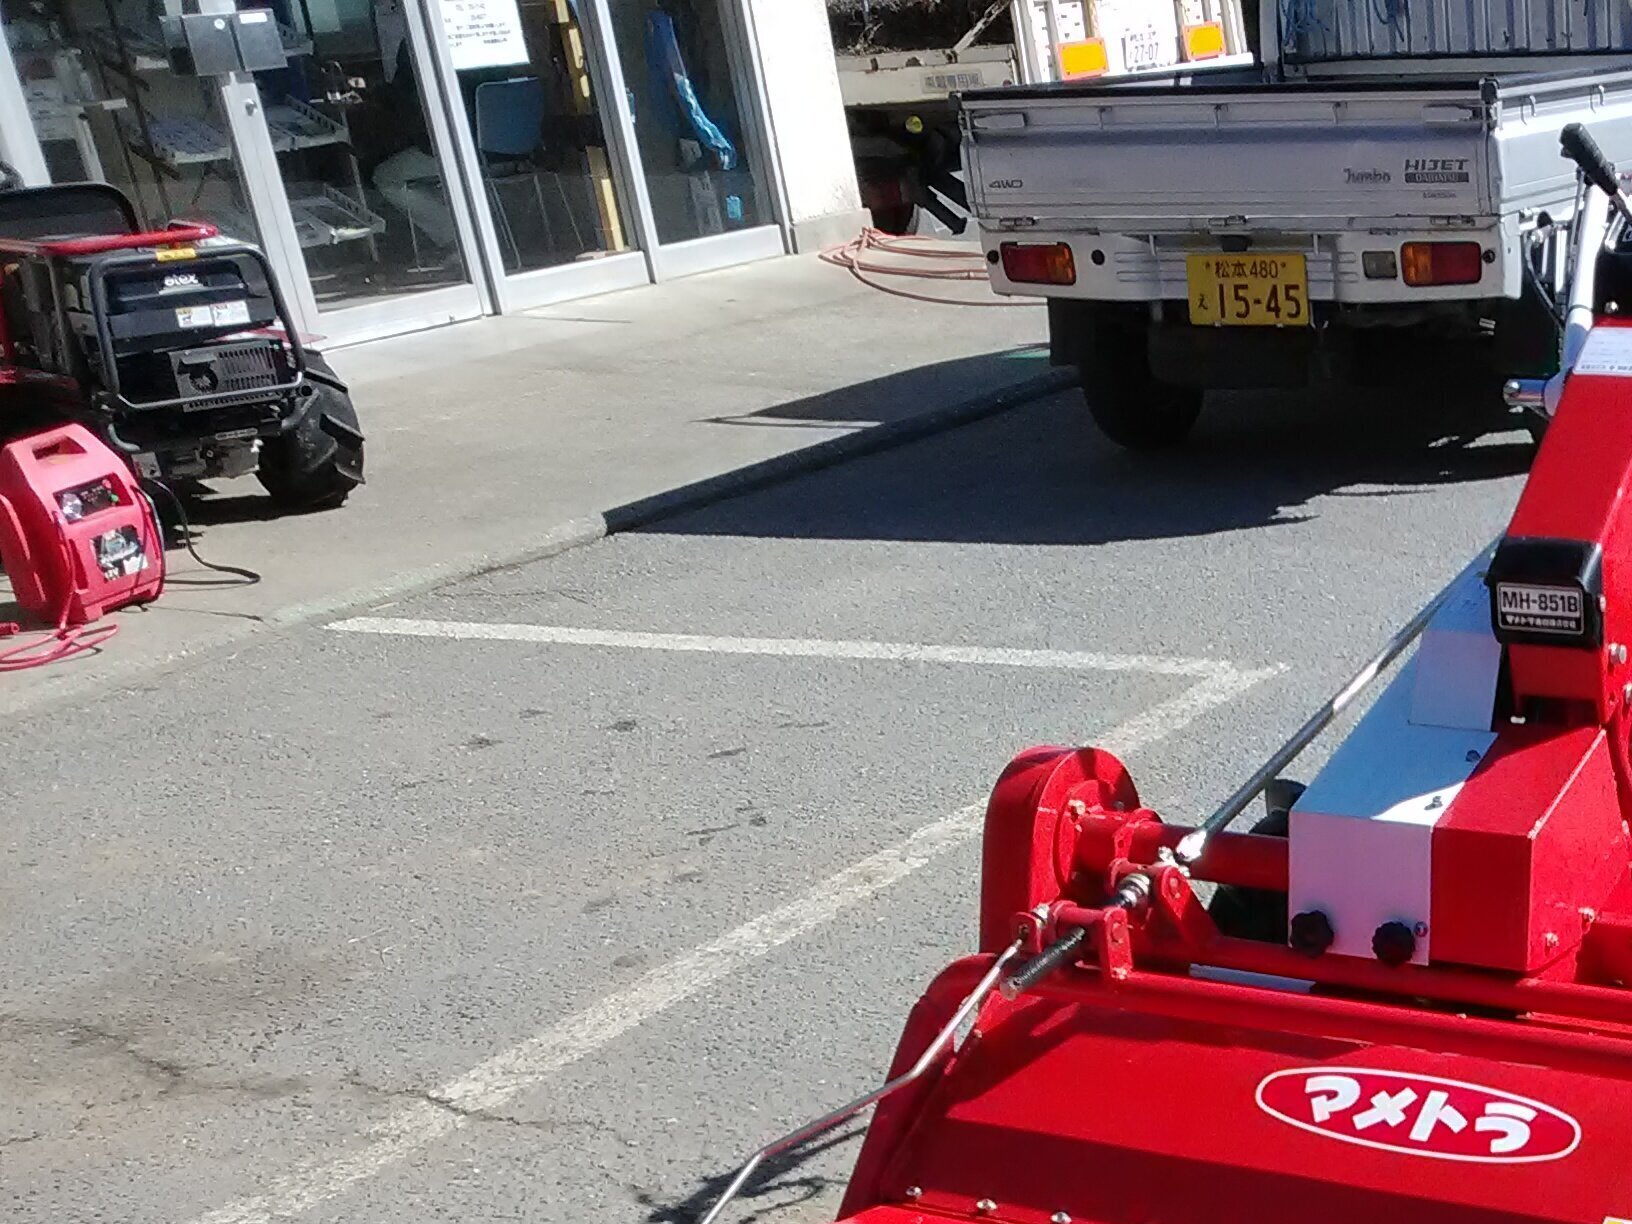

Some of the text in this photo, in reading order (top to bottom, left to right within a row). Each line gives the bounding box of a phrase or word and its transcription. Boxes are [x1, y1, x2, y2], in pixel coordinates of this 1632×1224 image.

[1404, 159, 1469, 171] HIJET
[989, 179, 1024, 189] 4WD
[1343, 167, 1391, 184] Jumbo
[1215, 260, 1279, 279] 松本 480
[1218, 283, 1301, 319] 15-45
[1502, 590, 1579, 613] MH-851B
